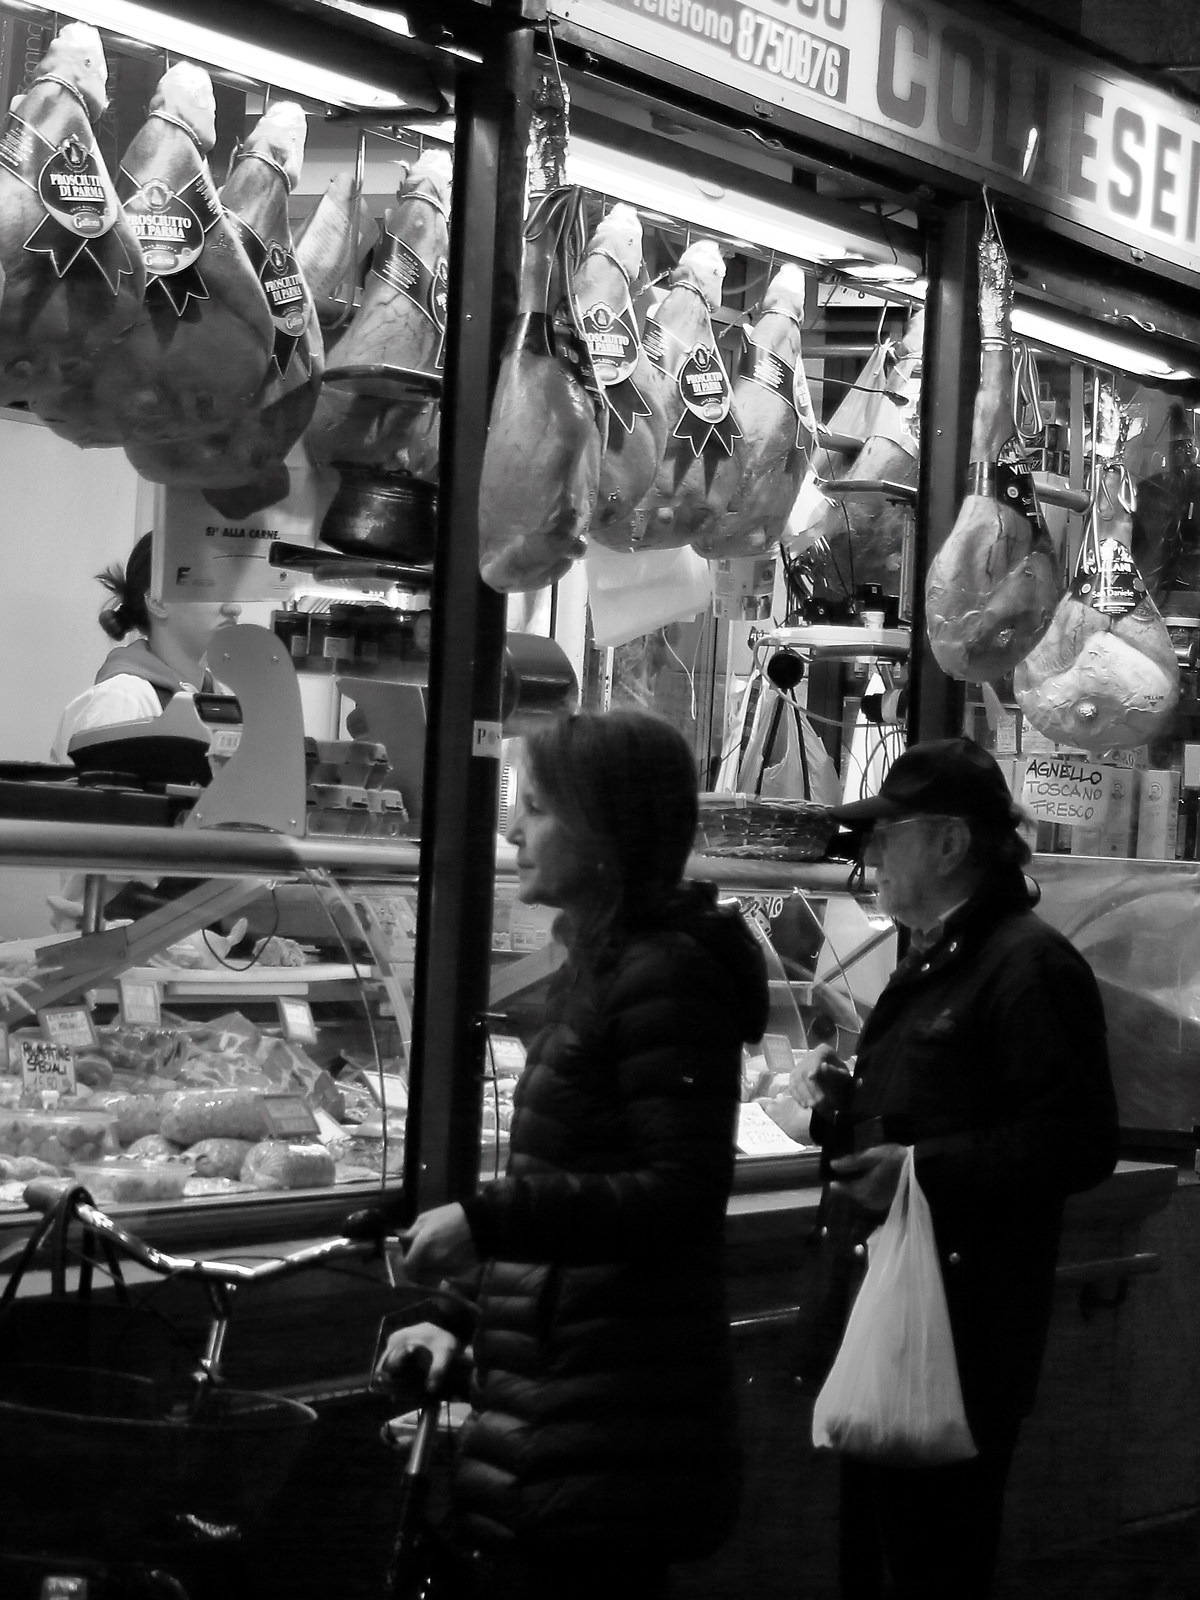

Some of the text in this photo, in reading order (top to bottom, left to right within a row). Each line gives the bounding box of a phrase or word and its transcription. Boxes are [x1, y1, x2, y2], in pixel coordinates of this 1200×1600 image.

[632, 0, 734, 44] elefono
[59, 185, 105, 198] DI PARMA
[148, 226, 186, 239] PARMA
[222, 527, 246, 537] ALLA
[1090, 562, 1132, 574] VANI
[1026, 759, 1103, 785] AGNELLO
[1025, 780, 1103, 801] TOSCANO
[1029, 800, 1095, 820] FRESCO
